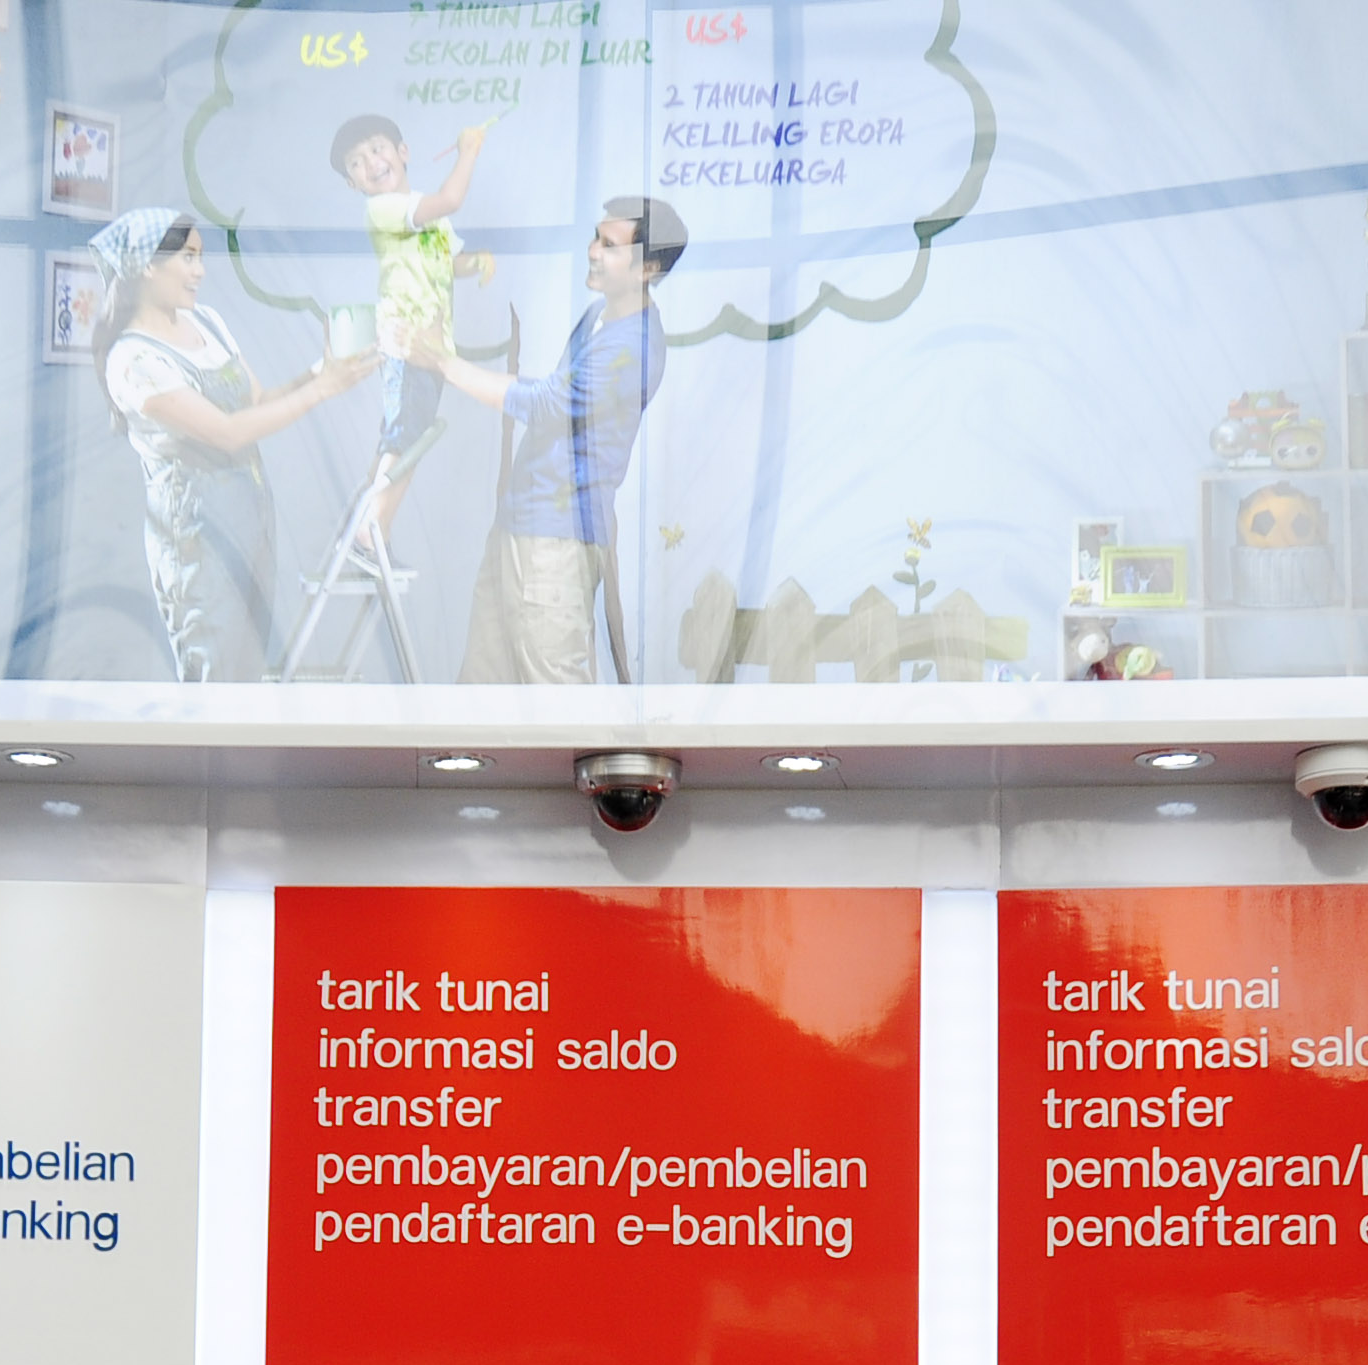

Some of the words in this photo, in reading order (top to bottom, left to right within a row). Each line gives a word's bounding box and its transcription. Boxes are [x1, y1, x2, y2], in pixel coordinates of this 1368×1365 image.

[437, 0, 521, 28] TAHUN
[531, 1, 601, 28] LAGI
[686, 12, 747, 44] US$
[300, 31, 369, 68] US$
[404, 40, 530, 66] SEKOLAH
[540, 40, 569, 66] DI
[581, 39, 654, 65] LUAR
[407, 78, 521, 104] NEGERI
[665, 86, 684, 108] 2
[694, 82, 778, 110] TAHUN
[788, 81, 858, 109] LAGI
[662, 121, 807, 148] KELILING
[820, 118, 905, 146] EROPA
[659, 158, 847, 187] SEKELUARGA
[317, 970, 420, 1011] tarik
[436, 972, 548, 1011] tunai
[1043, 970, 1145, 1011] tarik
[1161, 964, 1279, 1013] tunai
[320, 1028, 533, 1069] informasi
[558, 1030, 677, 1070] saldo
[1047, 1024, 1272, 1070] informasi
[314, 1087, 502, 1127] transfer
[1042, 1087, 1233, 1128] transfer
[317, 1145, 866, 1198] pembayaran/pembelian
[315, 1202, 595, 1251] pendaftaran
[617, 1205, 852, 1258] e-banking
[1047, 1205, 1336, 1257] pendaftaran
